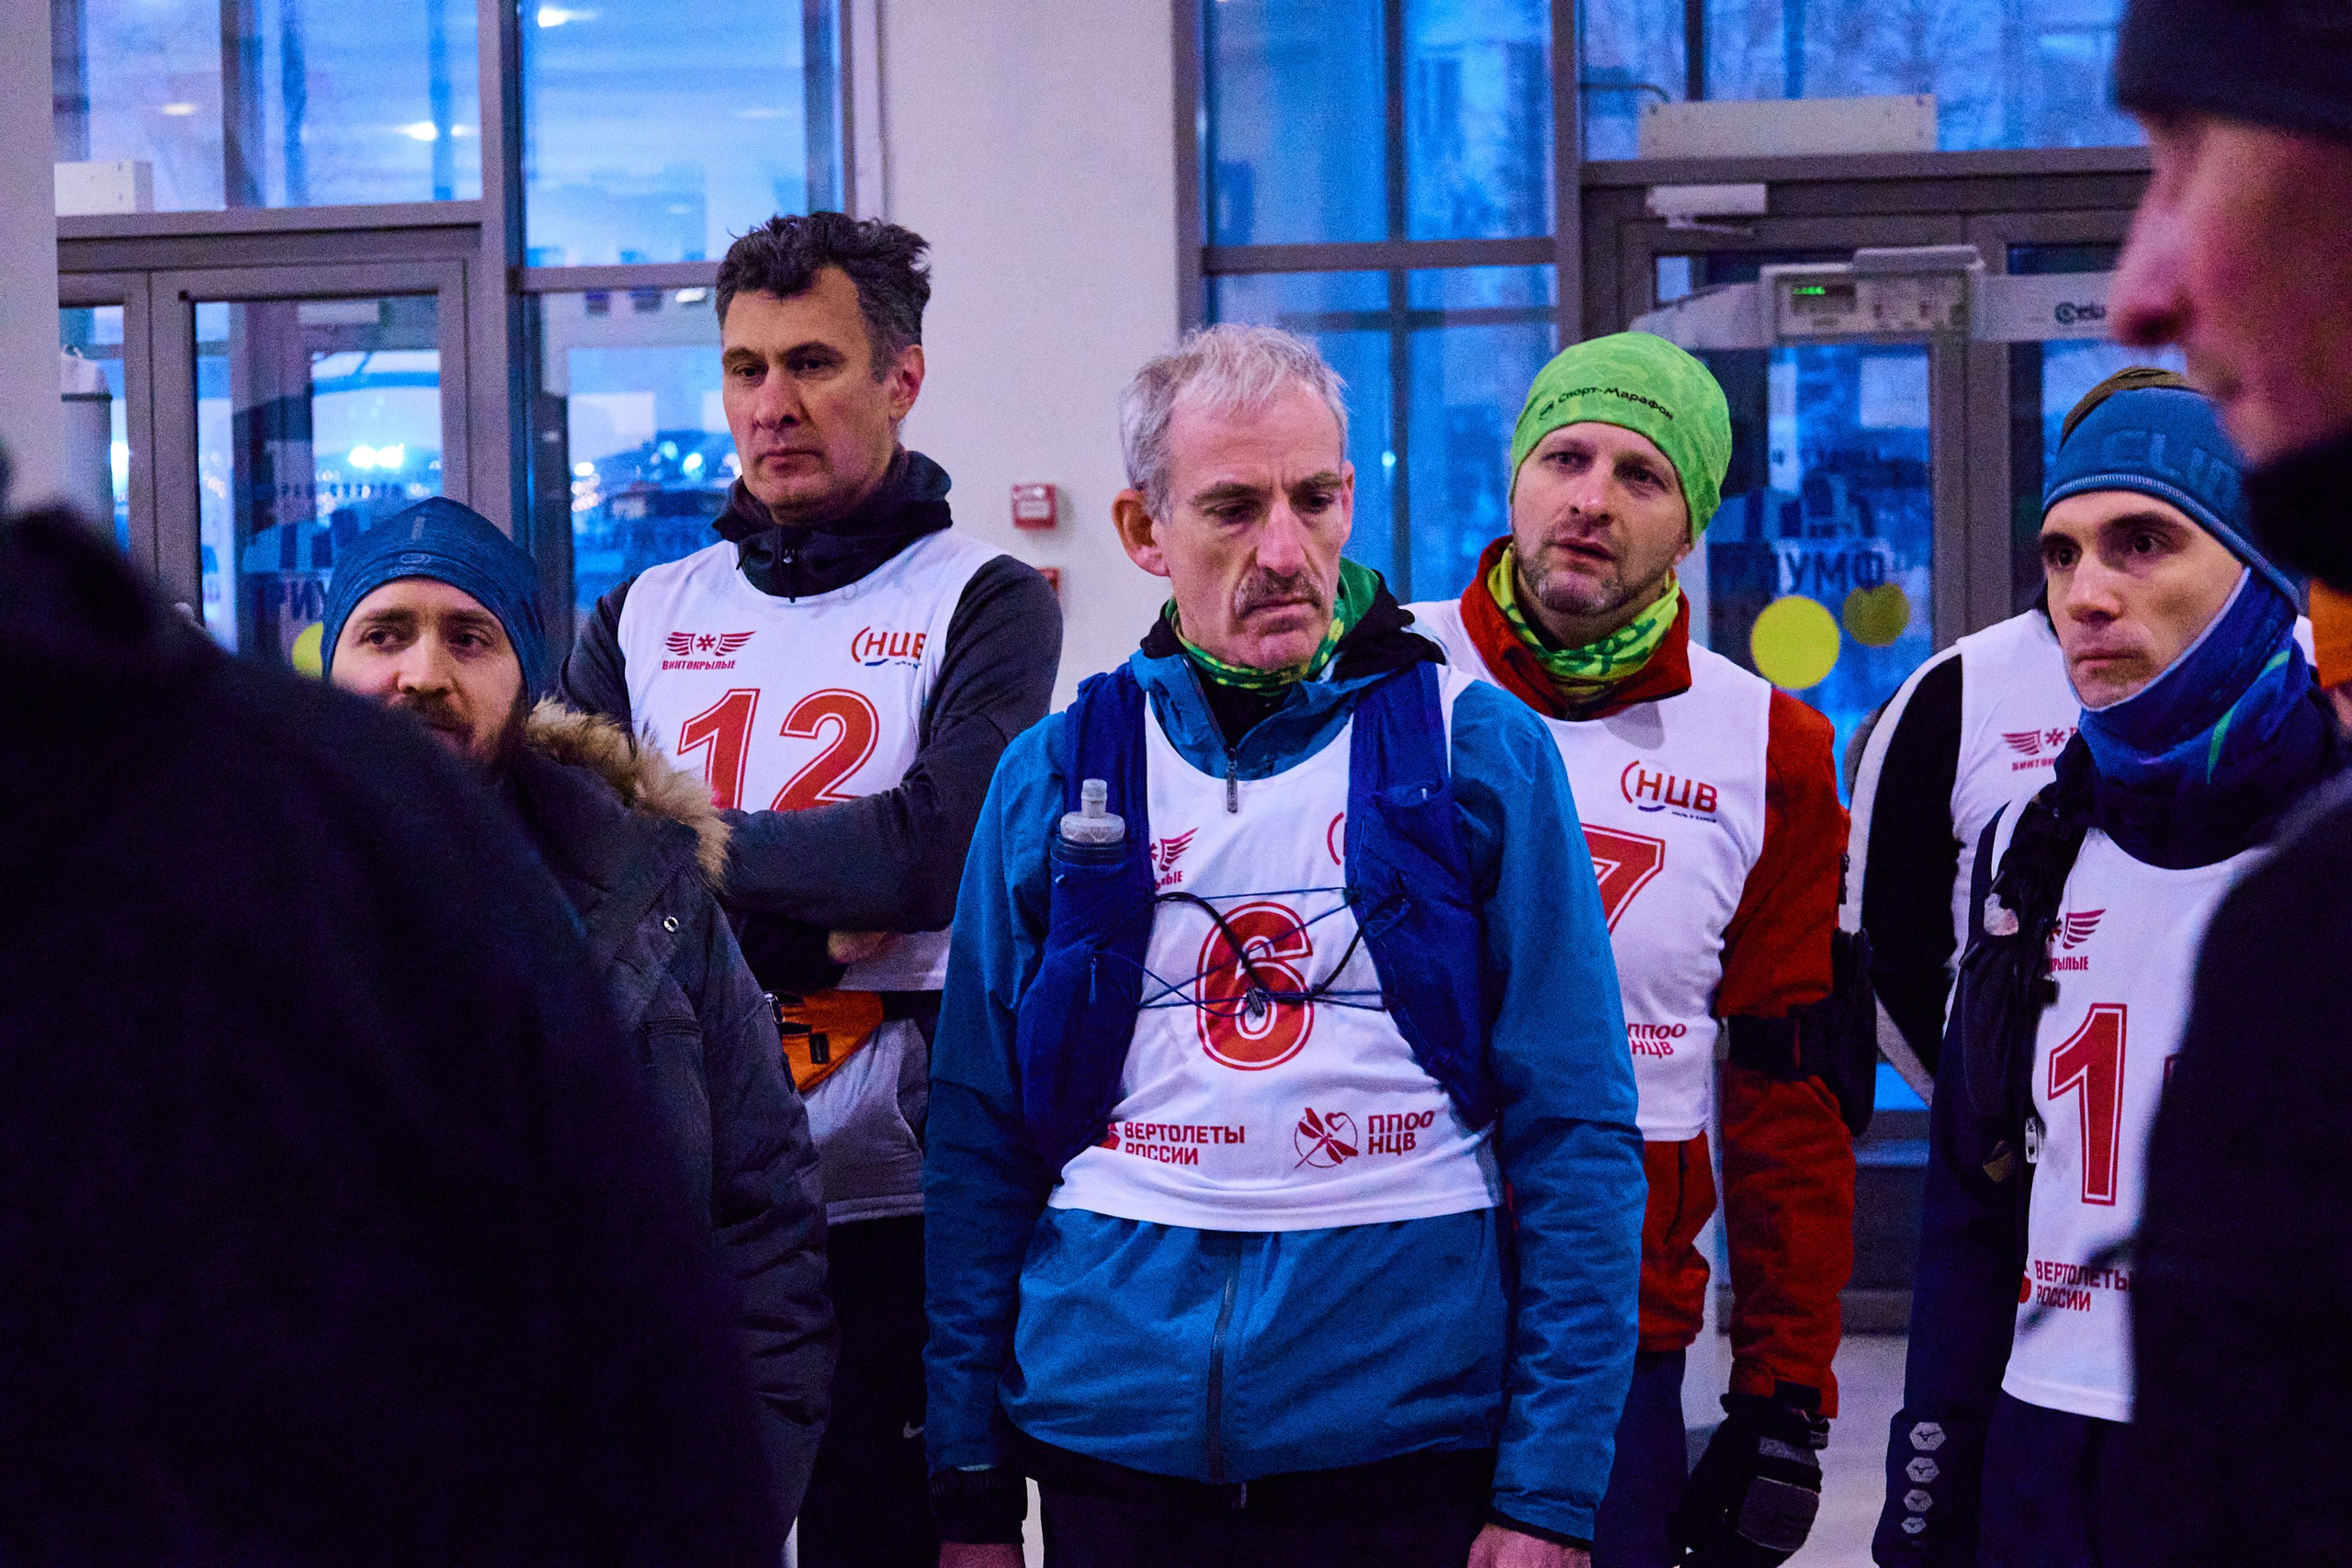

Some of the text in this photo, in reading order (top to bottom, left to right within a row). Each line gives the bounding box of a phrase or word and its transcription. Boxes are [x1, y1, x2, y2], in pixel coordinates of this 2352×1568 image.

[662, 660, 736, 671] ВИНТОКРЫЛЫЕ
[677, 688, 879, 812] 12
[1580, 822, 1666, 935] 7
[1196, 901, 1315, 1072] 6
[1627, 1022, 1687, 1040] ППОО
[1632, 1040, 1674, 1059] НЦВ
[1124, 1122, 1245, 1145] ВЕРТОЛЕТЫ
[1368, 1111, 1435, 1134] ППОО
[1368, 1132, 1417, 1156] НЦВ
[2036, 1283, 2092, 1313] РОССИИ
